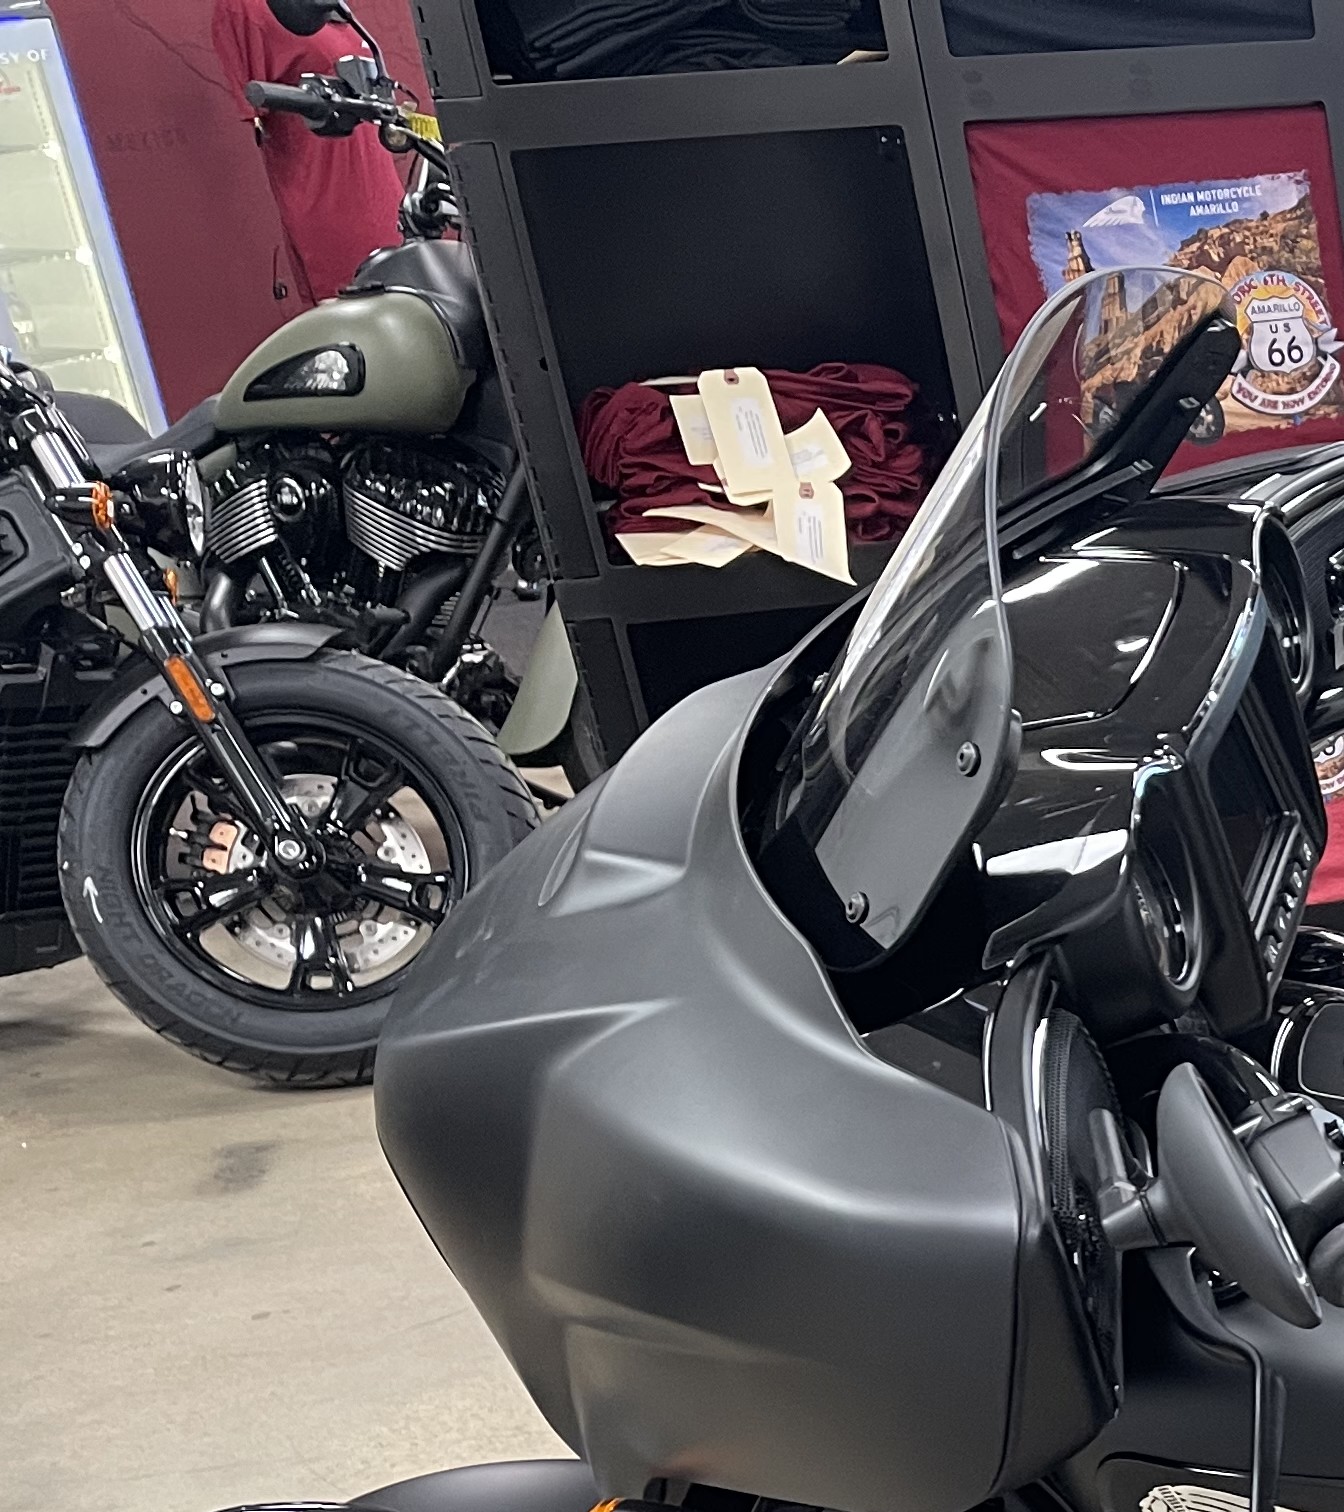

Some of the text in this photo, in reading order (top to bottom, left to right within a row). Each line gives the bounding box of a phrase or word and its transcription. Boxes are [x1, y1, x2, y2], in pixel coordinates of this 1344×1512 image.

[27, 49, 48, 63] OF
[1161, 185, 1262, 206] INDIAN MOTORCYCLE
[1190, 202, 1239, 217] AMARILLO
[1250, 301, 1301, 316] AMARILLO
[1293, 281, 1328, 325] STREET
[1267, 335, 1304, 367] 66
[1236, 382, 1259, 403] YOU
